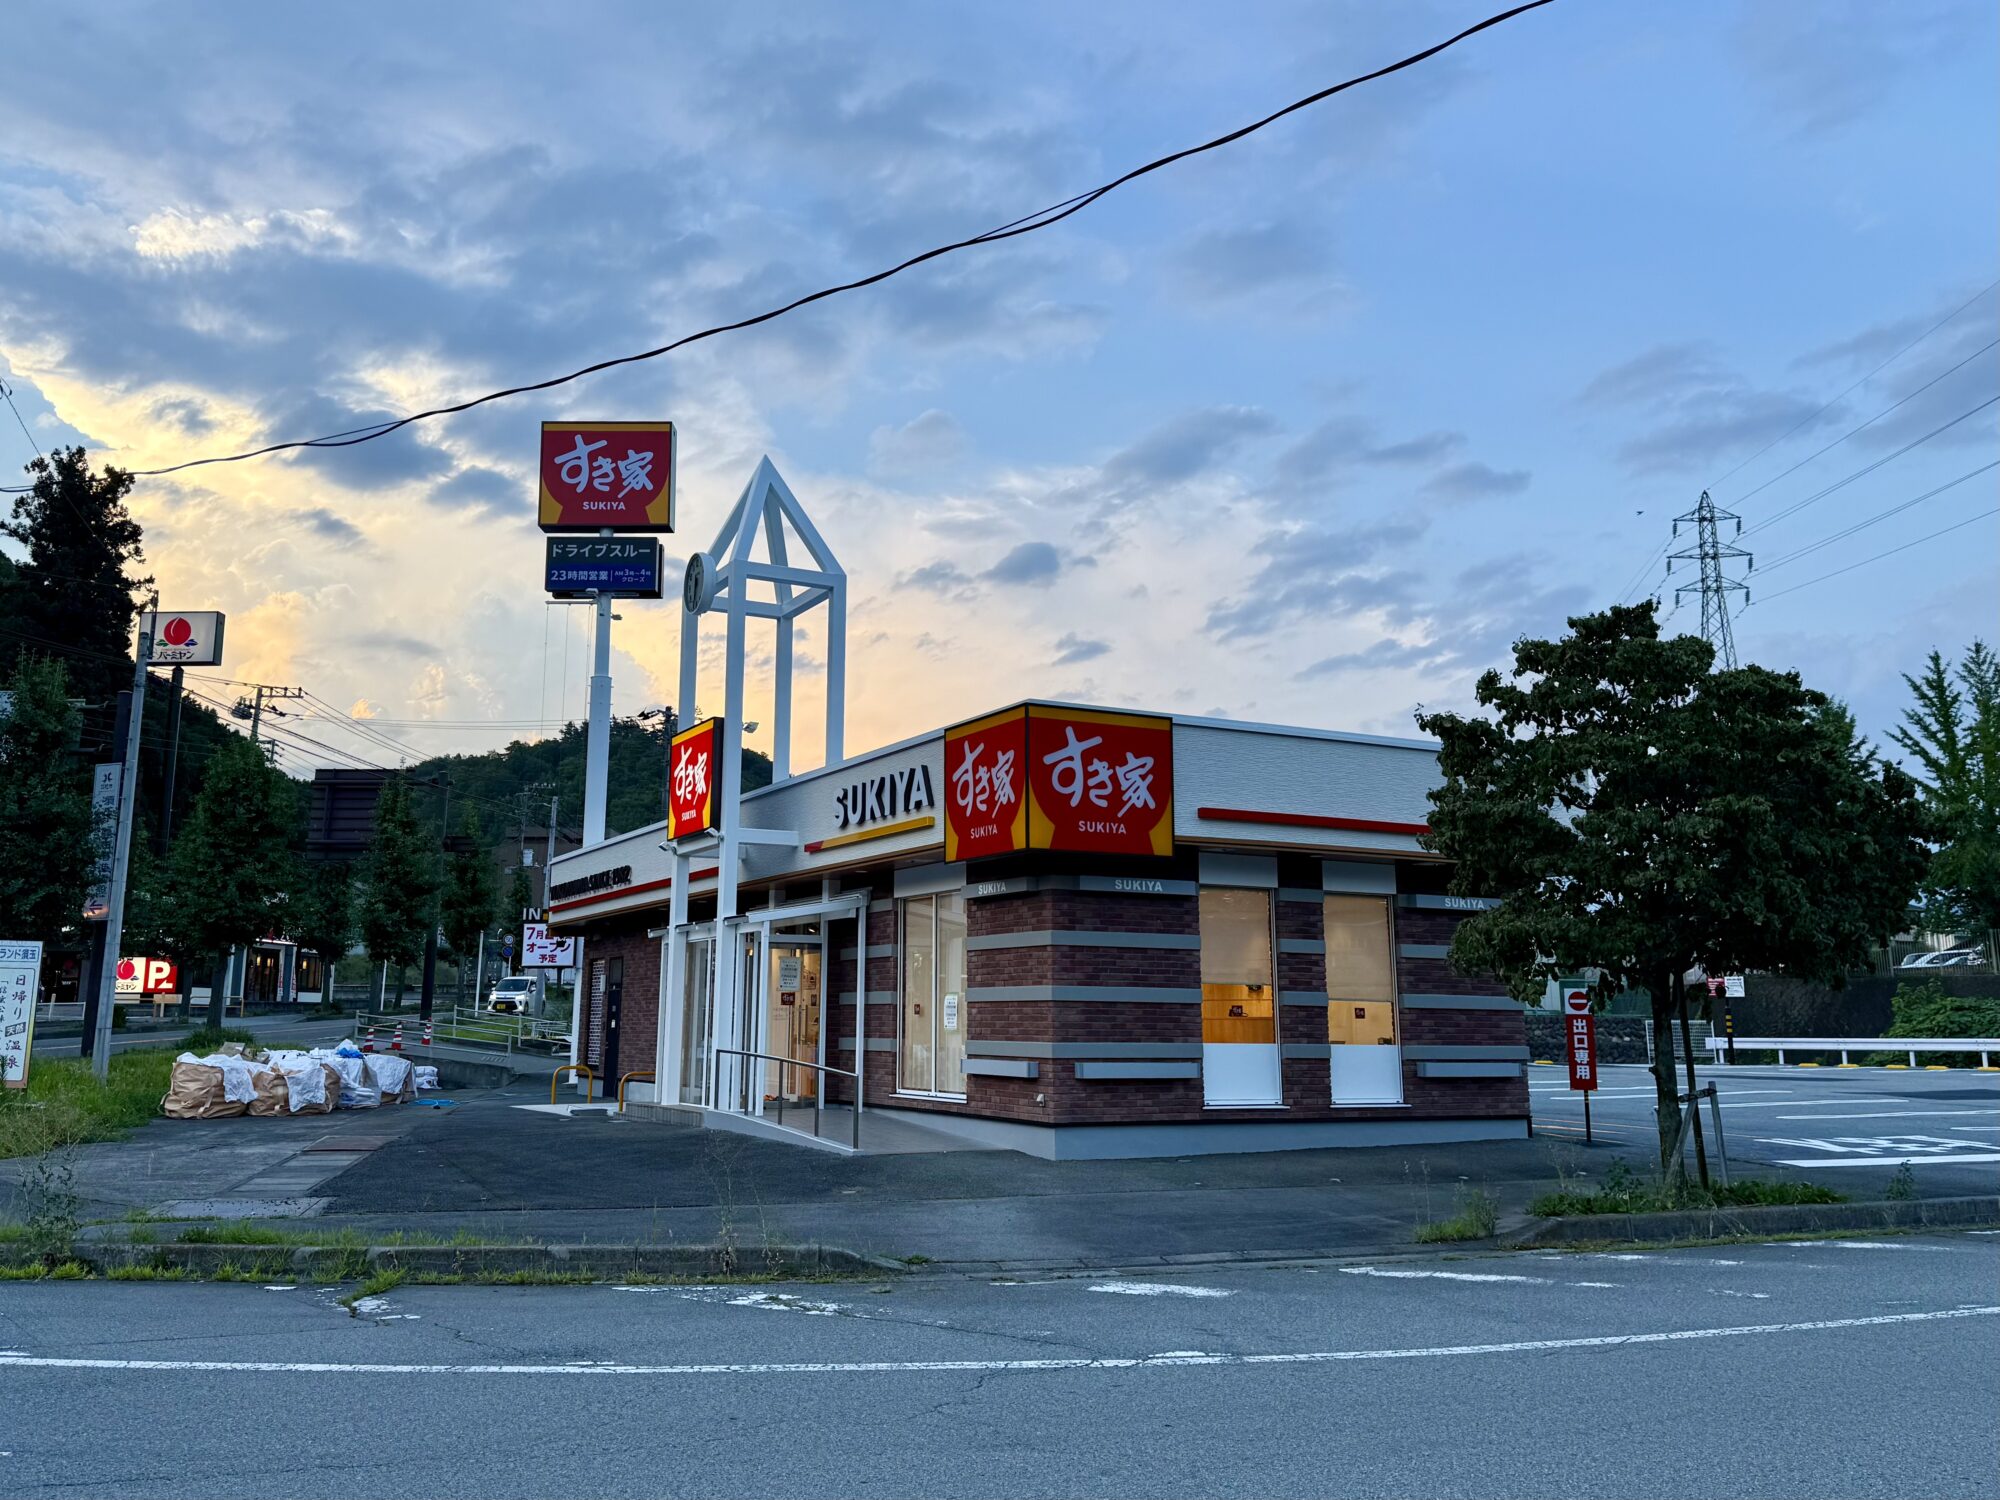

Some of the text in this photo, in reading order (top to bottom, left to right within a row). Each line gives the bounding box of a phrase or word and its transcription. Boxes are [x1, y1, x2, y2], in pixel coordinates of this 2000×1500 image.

[554, 434, 654, 499] すき家
[583, 501, 626, 511] SUKIYA
[552, 543, 651, 558] ドライブスルー
[156, 651, 195, 660] バーミヤン
[674, 745, 708, 806] すき家
[1042, 725, 1156, 818] すき家
[952, 740, 1016, 819] すき家
[834, 764, 935, 829] SUKIYA
[970, 823, 998, 839] SUKIYA
[1078, 820, 1127, 835] SUKIYA
[978, 881, 1007, 895] SUKIYA
[1115, 878, 1163, 893] SUKIYA
[1444, 897, 1485, 910] SUKIYA
[522, 907, 541, 920] IN
[538, 954, 557, 963] 予定
[147, 961, 171, 988] P
[1573, 1018, 1590, 1080] 出口専用
